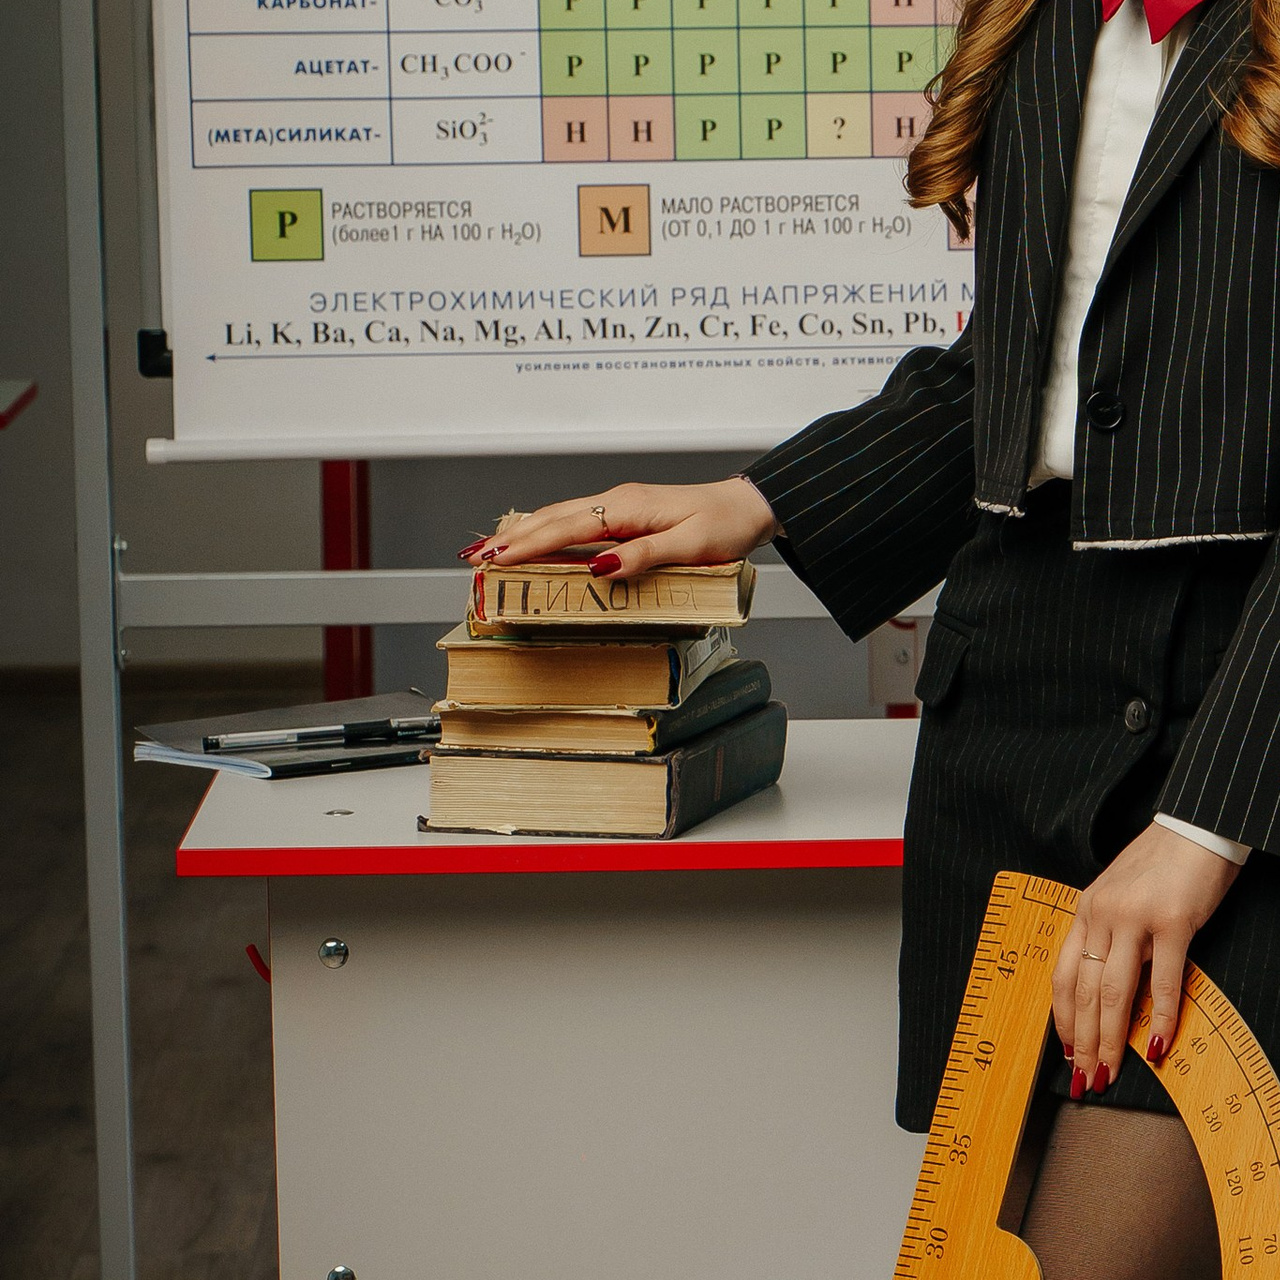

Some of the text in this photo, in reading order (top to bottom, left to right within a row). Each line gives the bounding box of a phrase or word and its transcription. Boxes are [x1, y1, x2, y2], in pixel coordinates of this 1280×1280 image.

[295, 60, 378, 76] АЦЕТАТ-
[208, 128, 380, 147] (МЕТА)СИЛИКАТ-
[332, 201, 471, 220] РАСТВОРЯЕТСЯ
[662, 194, 859, 214] МАЛО РАСТВОРЯЕТСЯ
[421, 224, 444, 241] НА
[453, 223, 481, 241] 100
[662, 220, 691, 240] (ОТ
[730, 218, 755, 239] ДО
[793, 218, 816, 234] НА
[824, 217, 852, 234] 100
[310, 286, 658, 313] ЭЛЕКТРОХИМИЧЕСКИЙ
[671, 288, 730, 310] РЯД
[743, 281, 948, 308] НАПРЯЖЕНИЙ
[1036, 920, 1056, 937] 10
[1023, 943, 1050, 963] 170
[997, 949, 1019, 980] 45
[975, 1040, 997, 1072] 40
[1190, 1035, 1208, 1056] 40
[1169, 1049, 1192, 1077] 140
[1224, 1093, 1243, 1115] 50
[1200, 1104, 1222, 1134] 130
[950, 1133, 972, 1166] 35
[1224, 1167, 1243, 1197] 120
[1250, 1161, 1266, 1183] 60
[926, 1227, 948, 1260] 30
[1239, 1236, 1253, 1265] 110
[1264, 1234, 1277, 1254] 70
